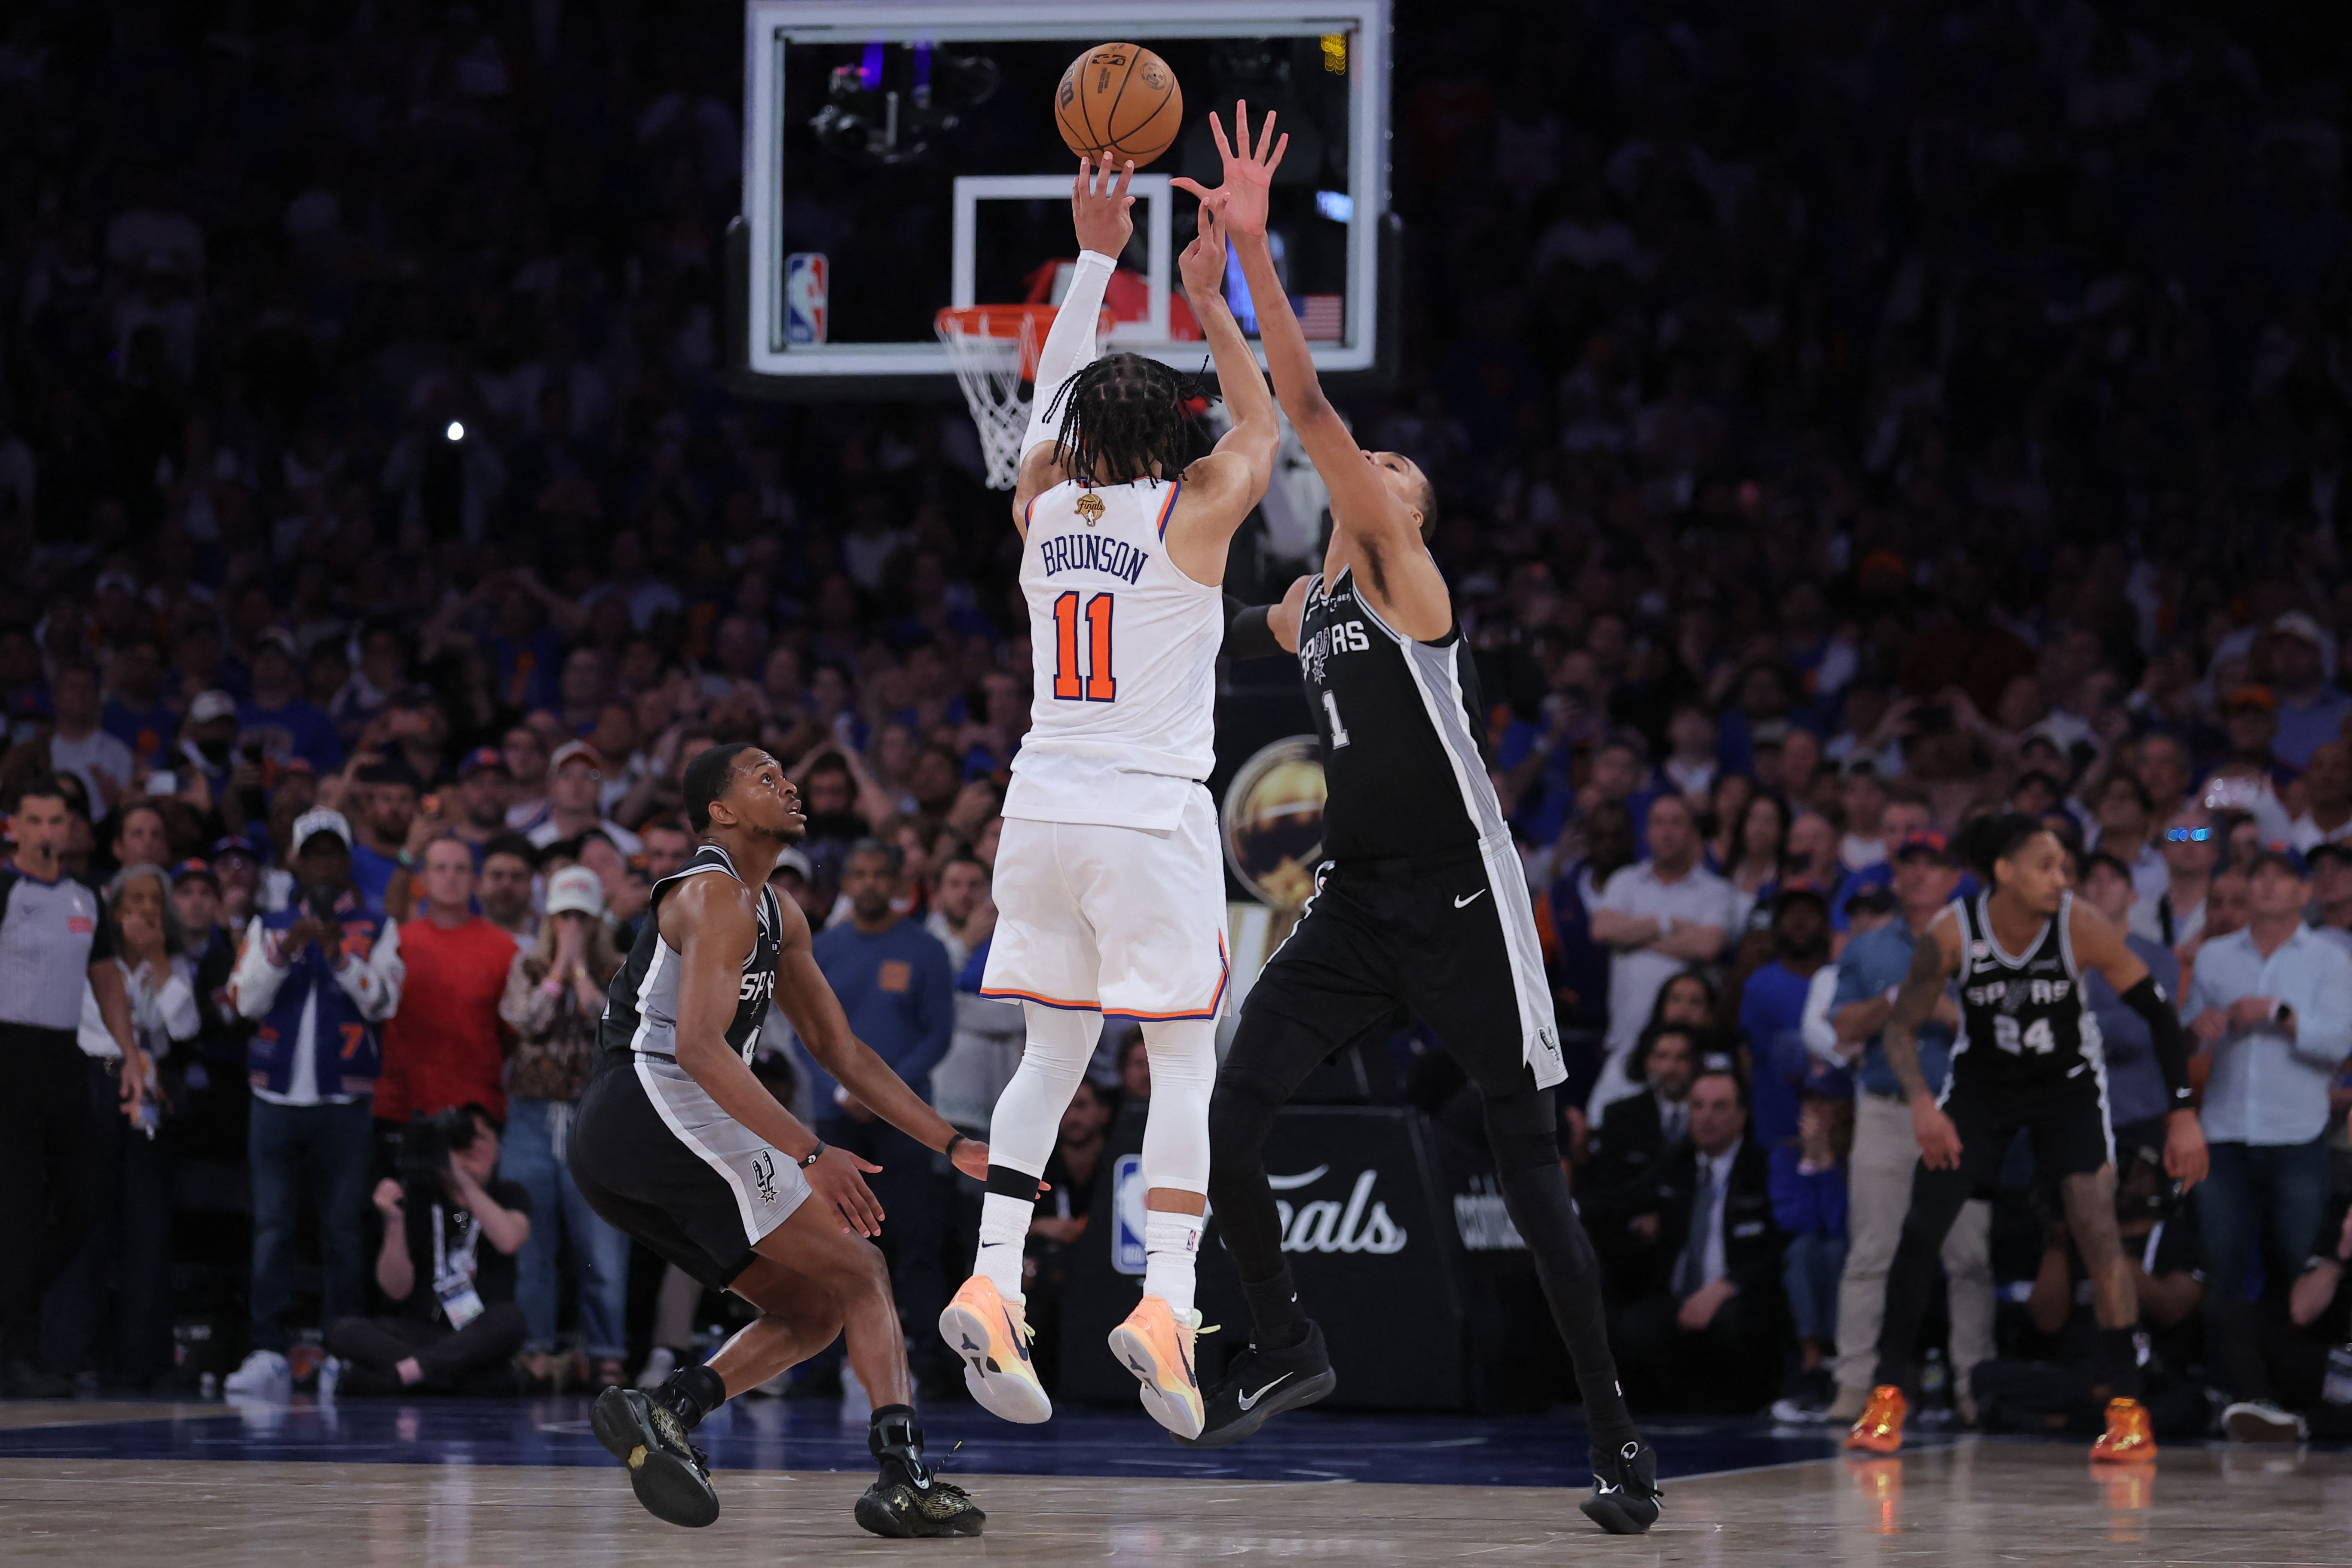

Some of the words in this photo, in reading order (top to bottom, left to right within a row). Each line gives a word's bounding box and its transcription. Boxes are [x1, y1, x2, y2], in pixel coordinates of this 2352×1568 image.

[1076, 499, 1104, 513] Finals
[1041, 534, 1149, 585] BRUNSON
[1053, 590, 1116, 703] 11
[1321, 689, 1350, 750] 1
[1993, 1014, 2055, 1056] 24
